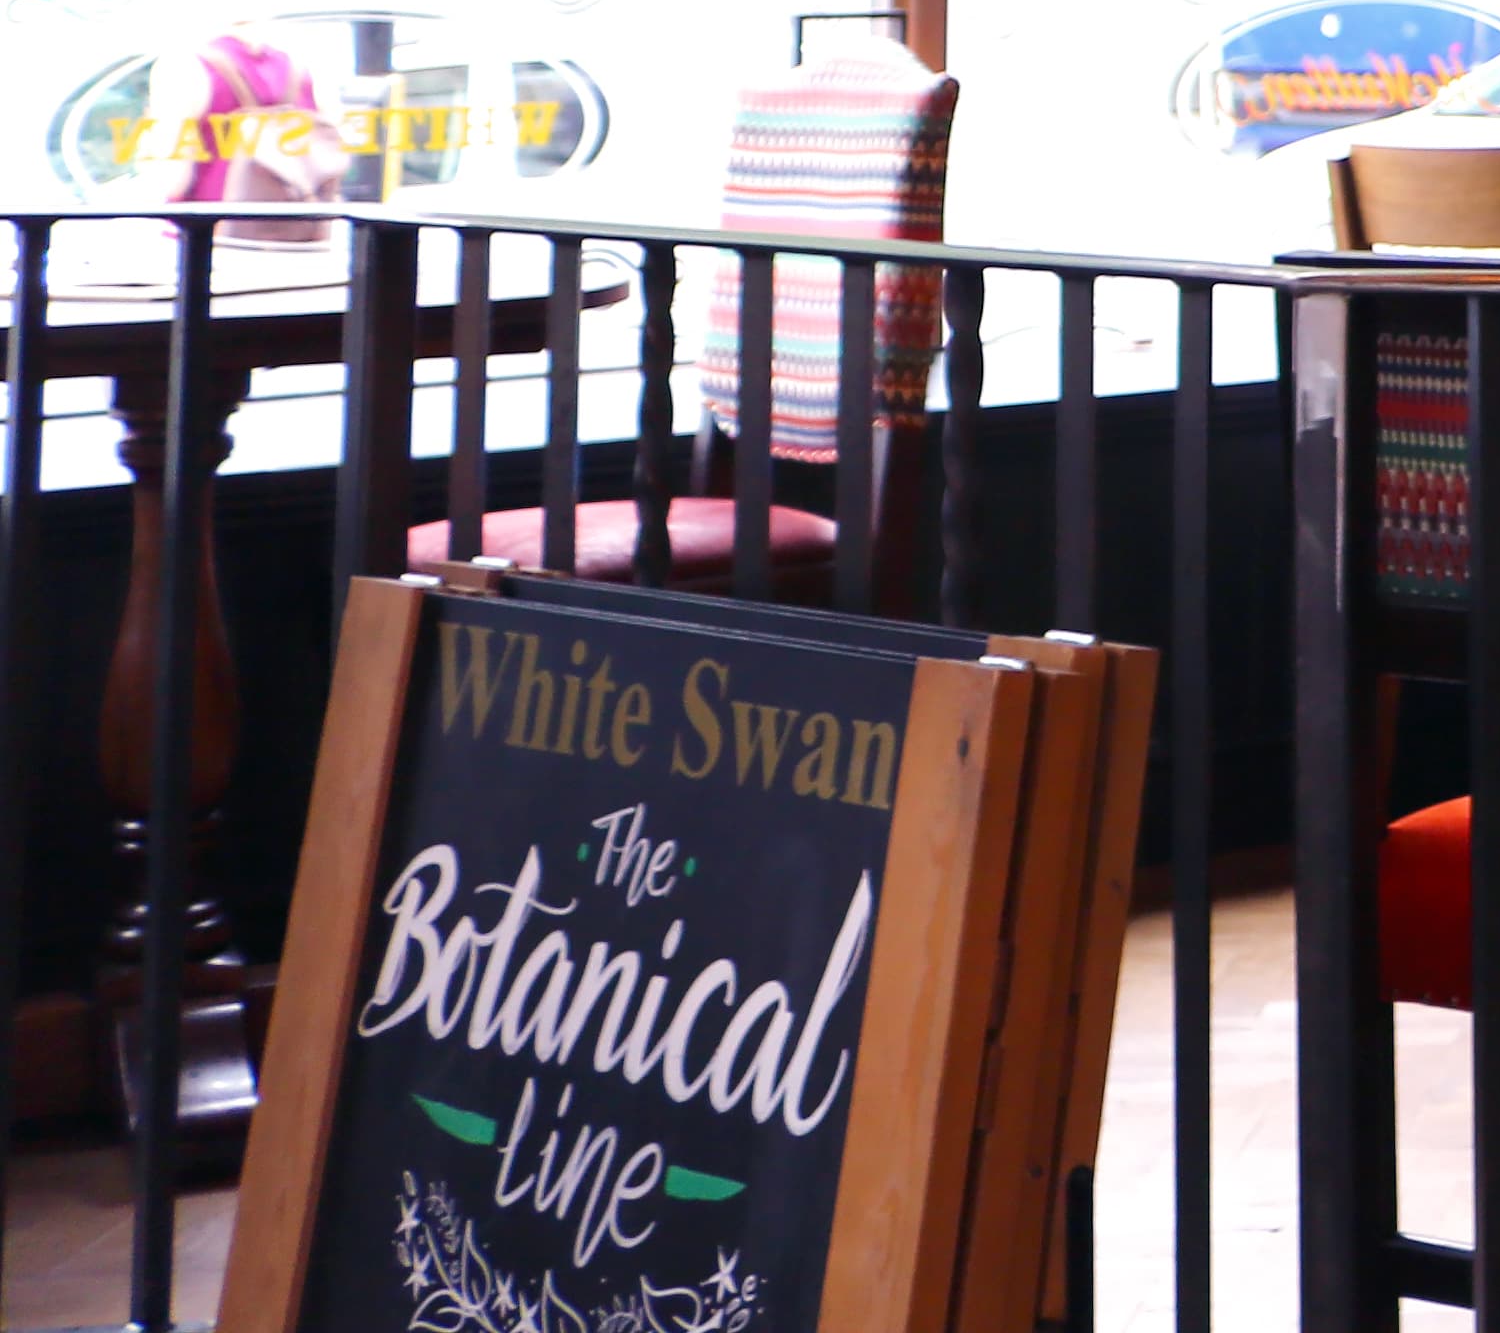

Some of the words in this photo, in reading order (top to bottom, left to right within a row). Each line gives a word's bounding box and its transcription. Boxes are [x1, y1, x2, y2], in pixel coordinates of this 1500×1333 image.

[438, 621, 653, 769] White
[670, 656, 897, 810] Swan
[590, 802, 677, 906] The
[358, 842, 873, 1137] Botanical
